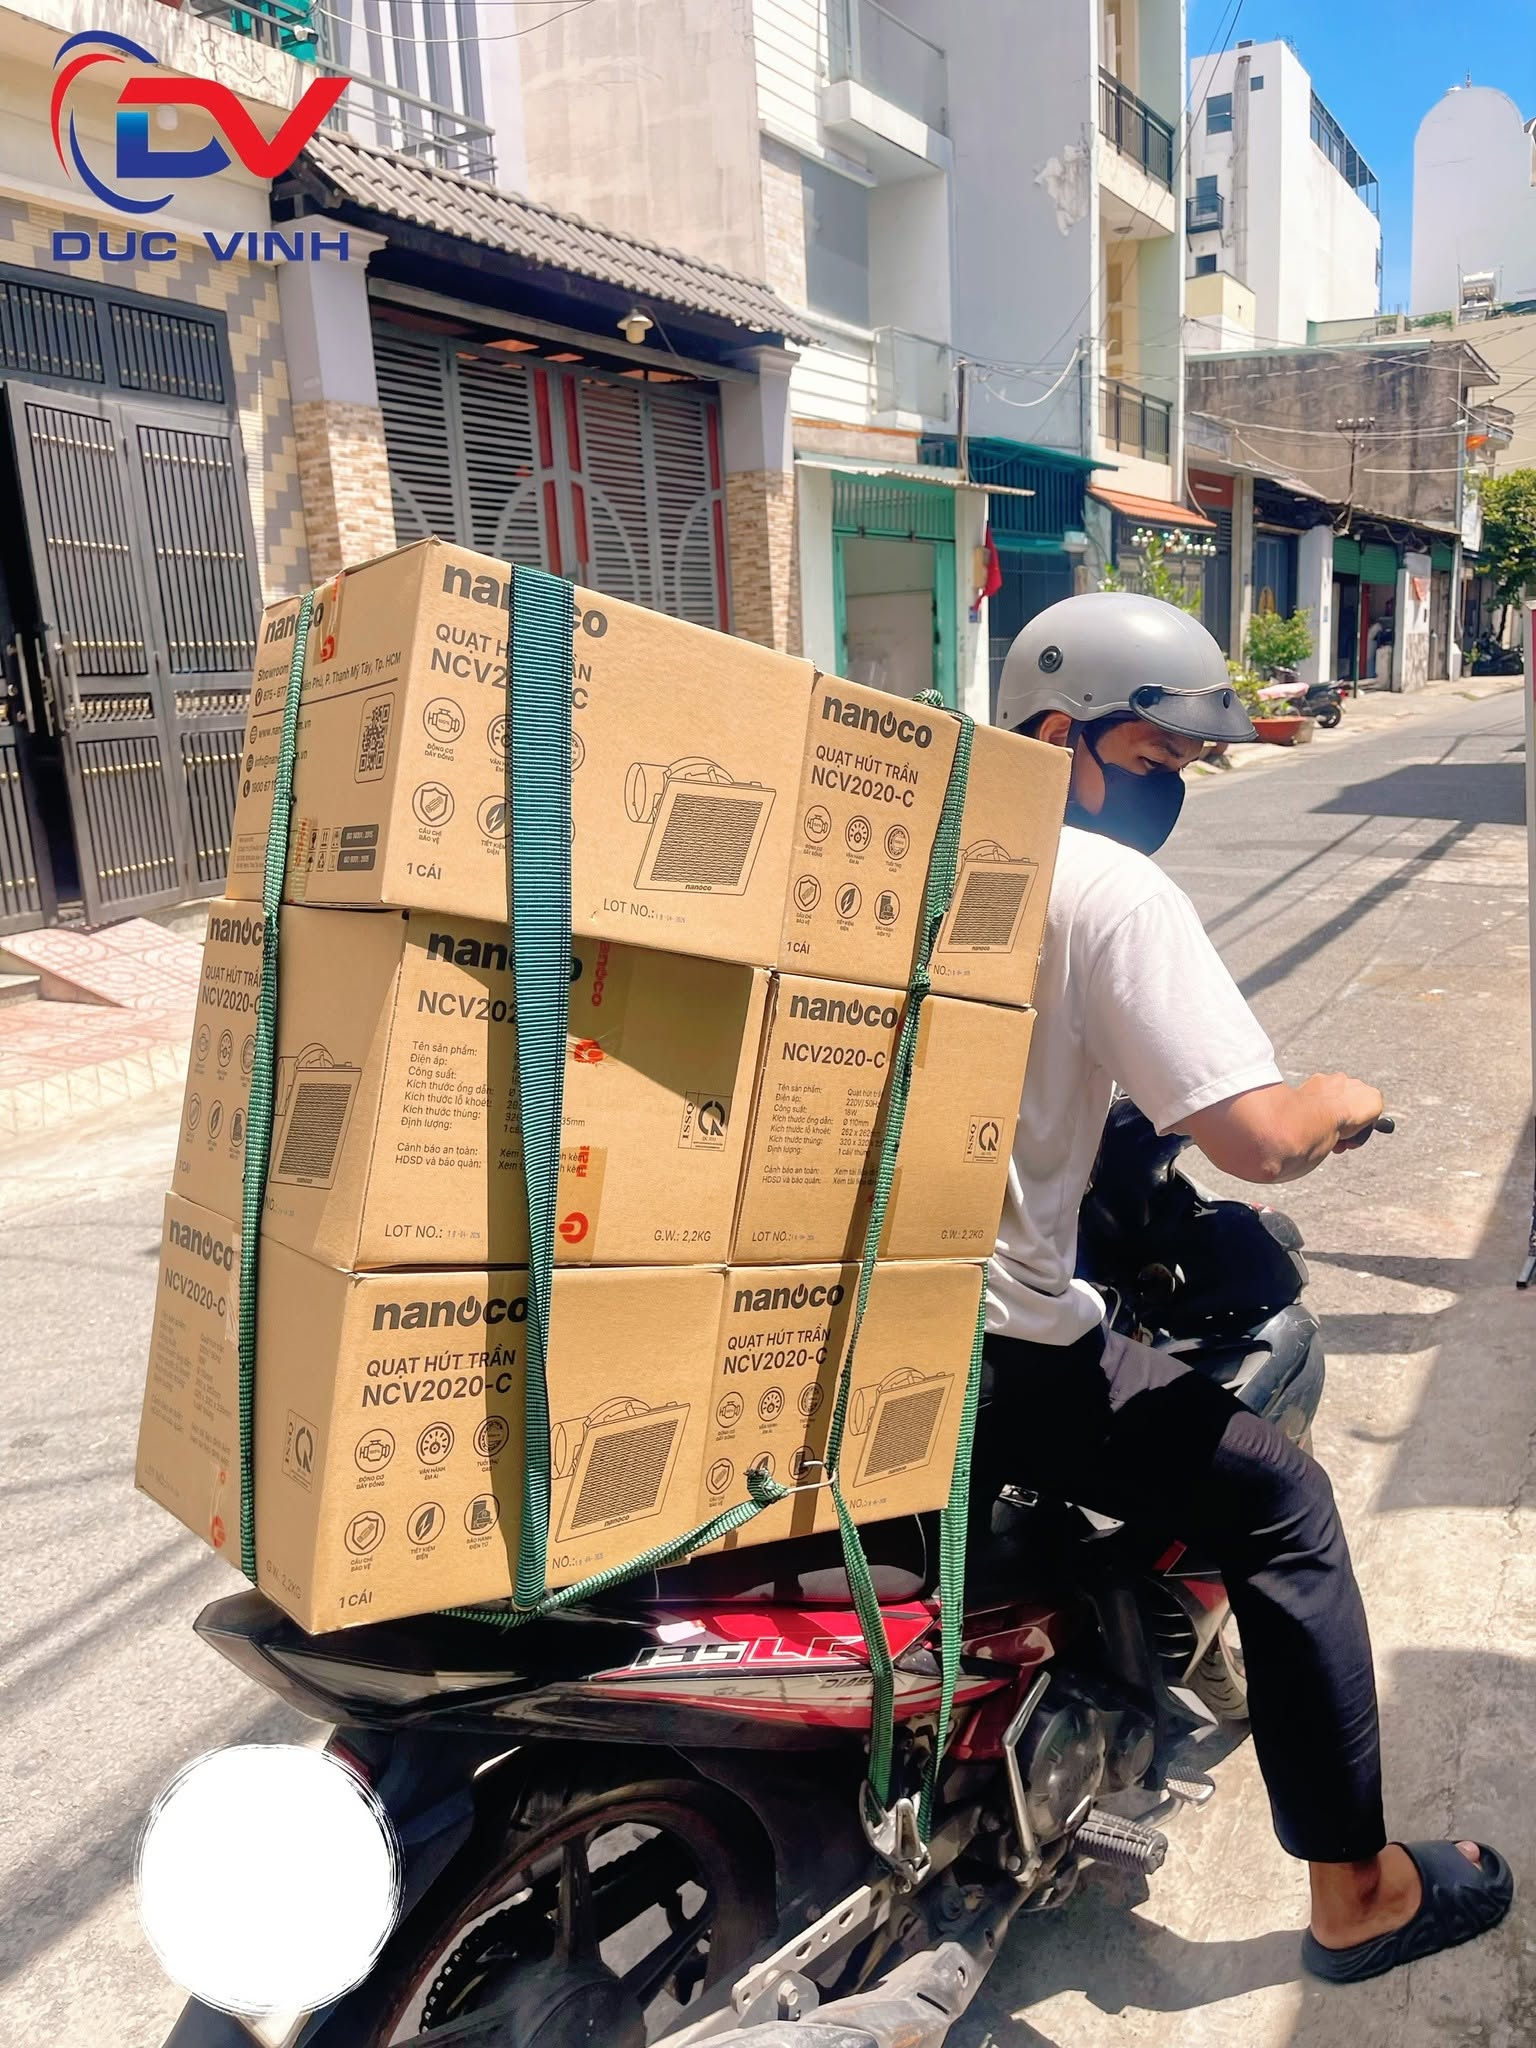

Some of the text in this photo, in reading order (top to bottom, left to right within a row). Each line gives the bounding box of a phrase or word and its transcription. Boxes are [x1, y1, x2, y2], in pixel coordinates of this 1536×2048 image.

[436, 623, 491, 654] QUẠT
[822, 695, 932, 748] nanoco
[816, 745, 918, 785] QUẠT HÚT TRẦN
[811, 764, 915, 808] NCV2020-C
[406, 862, 442, 880] 1 CÁI
[603, 898, 654, 918] LOT NO.:
[209, 917, 263, 946] nanoc
[793, 941, 810, 955] CÁI
[205, 965, 225, 984] QUẠT
[226, 966, 242, 984] HÚT
[789, 994, 898, 1029] nanoco
[412, 1041, 430, 1051] Tên
[432, 1043, 448, 1053] sản
[781, 1041, 886, 1069] NCV2020-C
[410, 1053, 448, 1067] Điện áp:
[408, 1066, 457, 1079] Công suất:
[406, 1079, 427, 1089] Kích
[429, 1081, 454, 1091] thước
[457, 1081, 473, 1095] ống
[404, 1091, 425, 1102] Kích
[427, 1093, 453, 1104] thước
[455, 1094, 463, 1105] lỗ
[402, 1104, 481, 1121] Kích thước thùng:
[401, 1117, 452, 1131] Định lượng:
[397, 1142, 421, 1152] Cảnh
[423, 1144, 441, 1154] báo
[443, 1146, 454, 1154] an
[456, 1146, 478, 1156] toàn:
[395, 1155, 423, 1165] HDSD
[425, 1157, 436, 1165] và
[438, 1157, 455, 1167] bảo
[457, 1158, 482, 1169] quản:
[762, 1175, 781, 1184] HDSD
[384, 1223, 711, 1243] LOT NO.: G.W.: 2,2KG
[752, 1231, 771, 1242] LOT
[169, 1218, 233, 1272] nanoco
[164, 1267, 226, 1318] NCV2020-C
[733, 1283, 845, 1313] nanoco
[372, 1295, 528, 1331] nanoco
[727, 1323, 831, 1352] QUẠT HÚT TRẦN
[366, 1344, 516, 1379] QUẠT HÚT TRẦN
[723, 1347, 827, 1375] NCV2020-C
[361, 1372, 513, 1408] NCV2020-C
[339, 1589, 372, 1608] 1 CÁI
